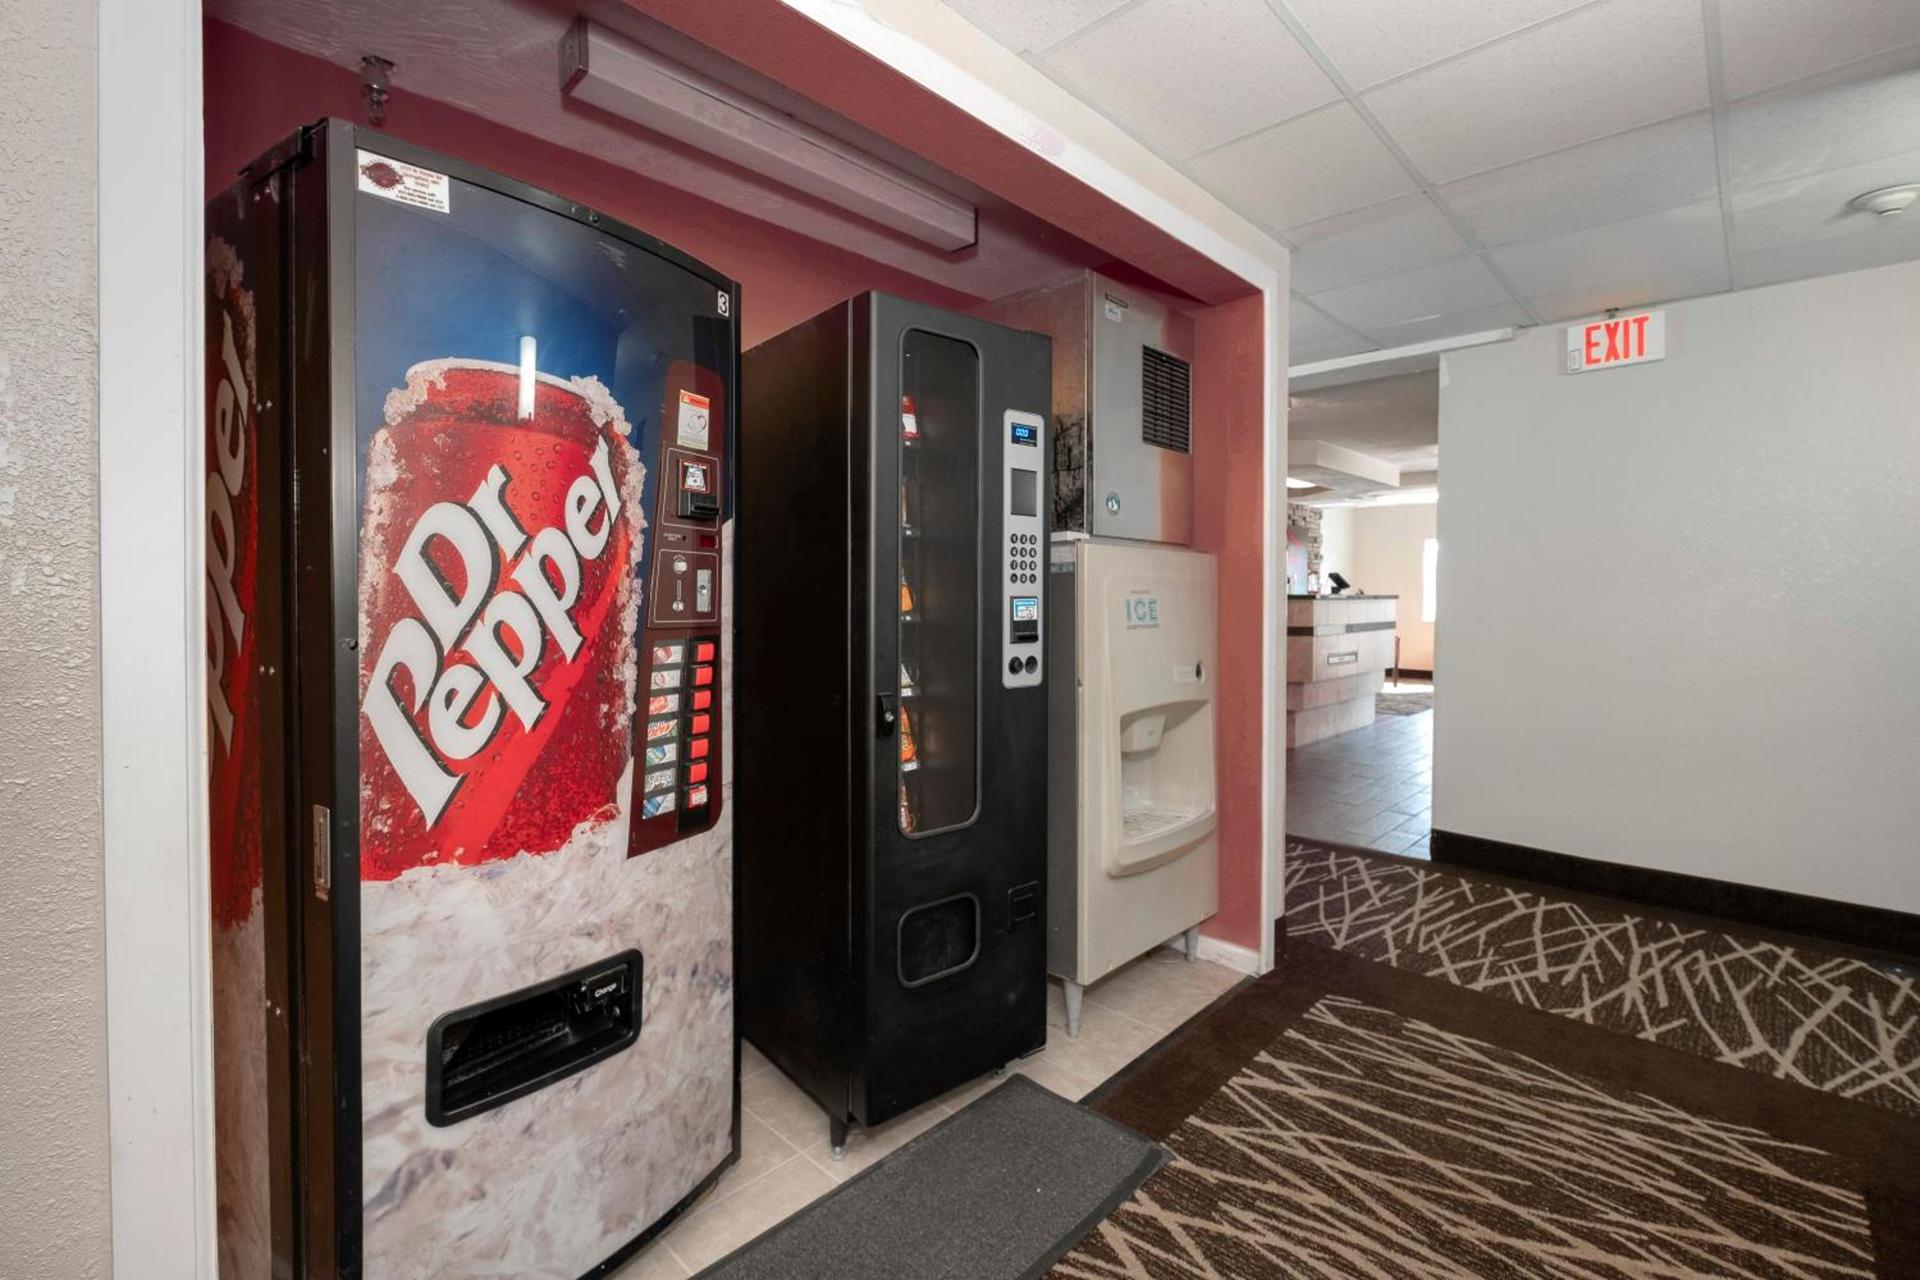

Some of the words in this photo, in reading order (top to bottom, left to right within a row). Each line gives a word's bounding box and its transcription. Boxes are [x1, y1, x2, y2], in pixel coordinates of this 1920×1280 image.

[720, 294, 728, 314] 3
[1585, 315, 1650, 365] EXIT
[394, 464, 528, 655] Dr
[362, 436, 621, 832] Pepper
[1126, 597, 1158, 623] ICE
